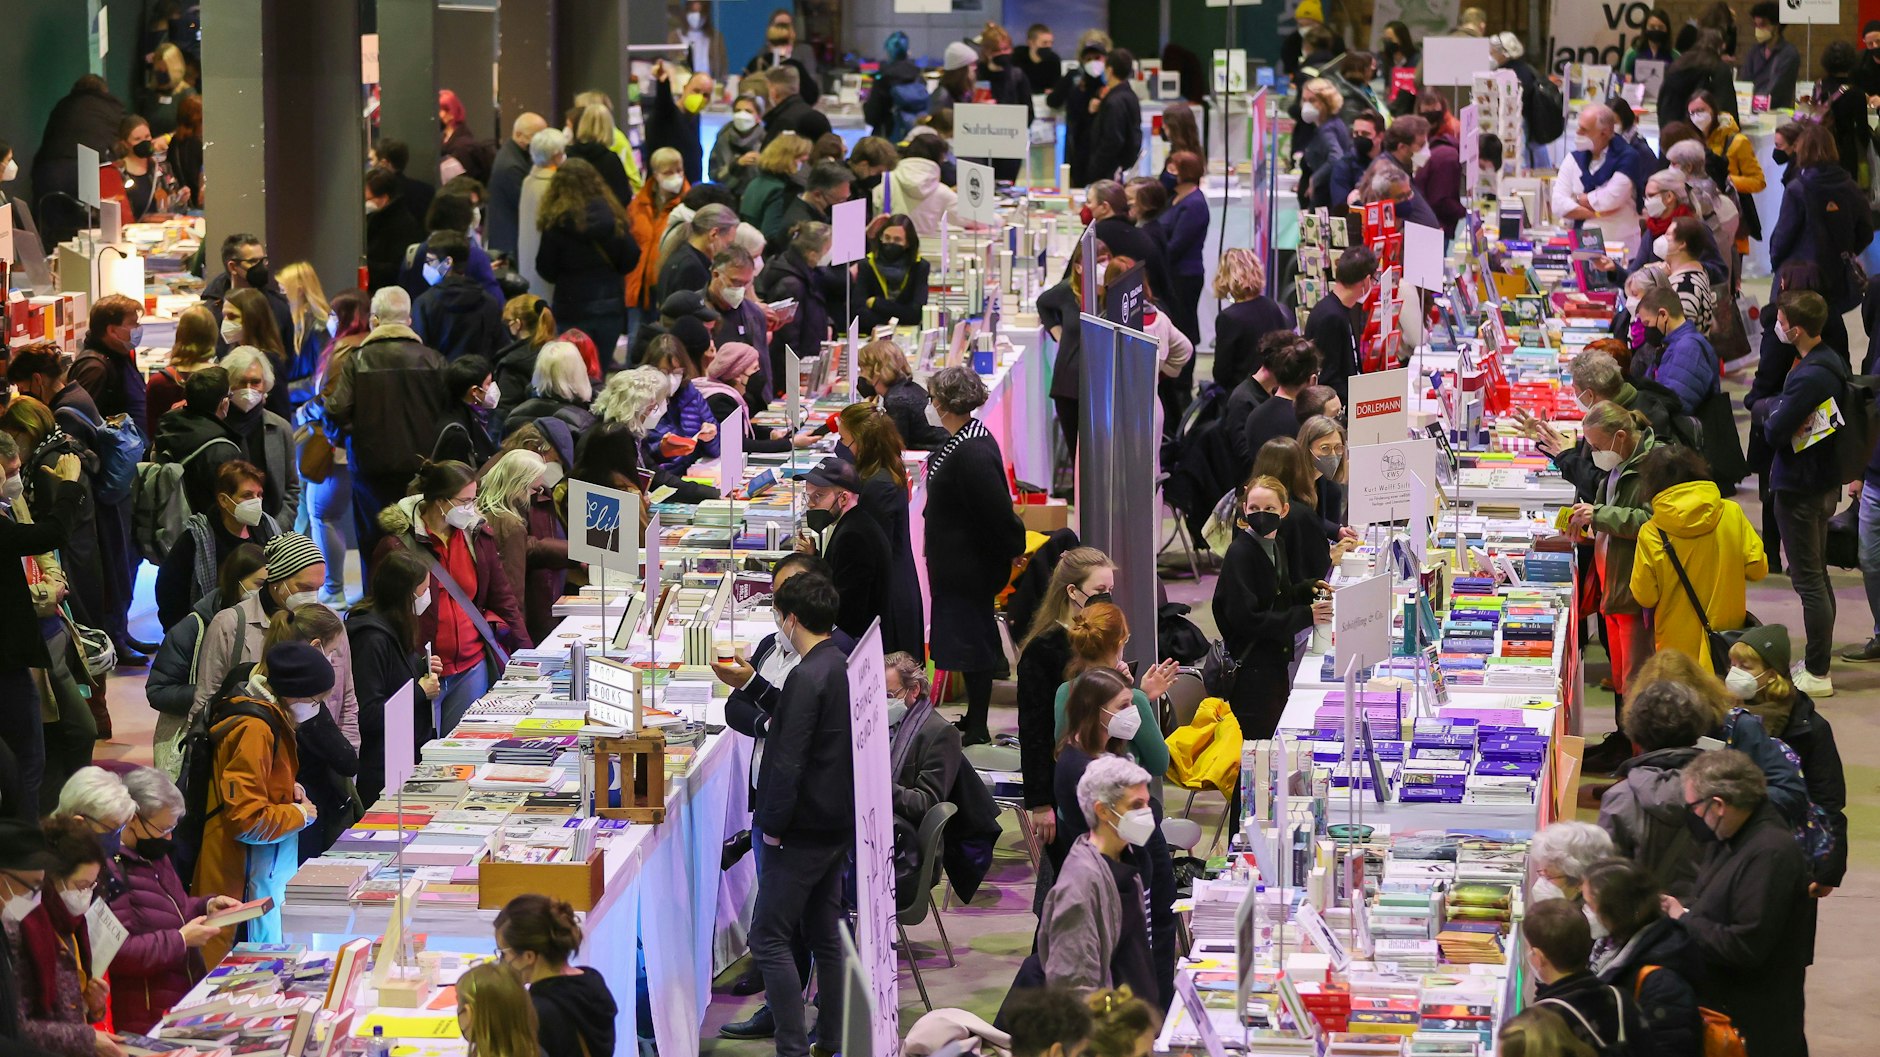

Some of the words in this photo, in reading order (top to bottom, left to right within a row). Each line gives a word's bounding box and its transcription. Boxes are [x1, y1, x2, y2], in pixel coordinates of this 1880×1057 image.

[962, 122, 1018, 139] Suhrkamp
[1357, 399, 1401, 416] DÖRLEMANN
[1386, 470, 1400, 478] KWS
[586, 500, 620, 551] Elif
[594, 684, 621, 704] BOOKS
[593, 703, 629, 727] BERLIN
